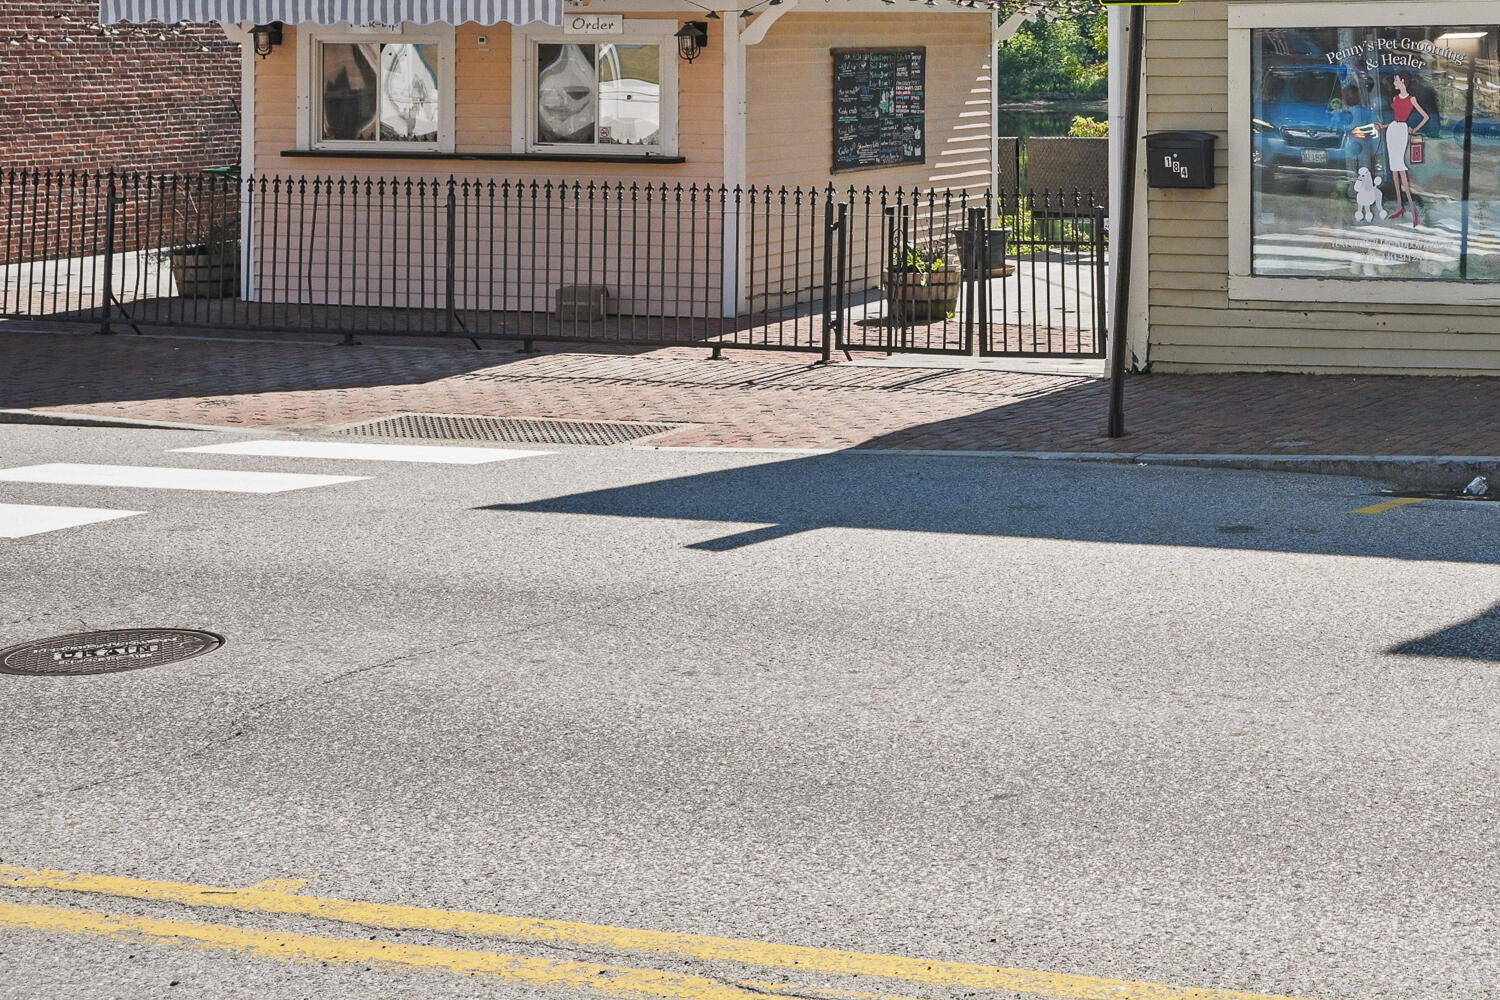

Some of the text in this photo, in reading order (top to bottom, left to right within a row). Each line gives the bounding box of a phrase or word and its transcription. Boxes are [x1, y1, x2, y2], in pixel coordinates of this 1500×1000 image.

[571, 17, 614, 30] Order
[1326, 37, 1465, 66] Penny's Pet Grooming
[1366, 53, 1426, 70] & Healer
